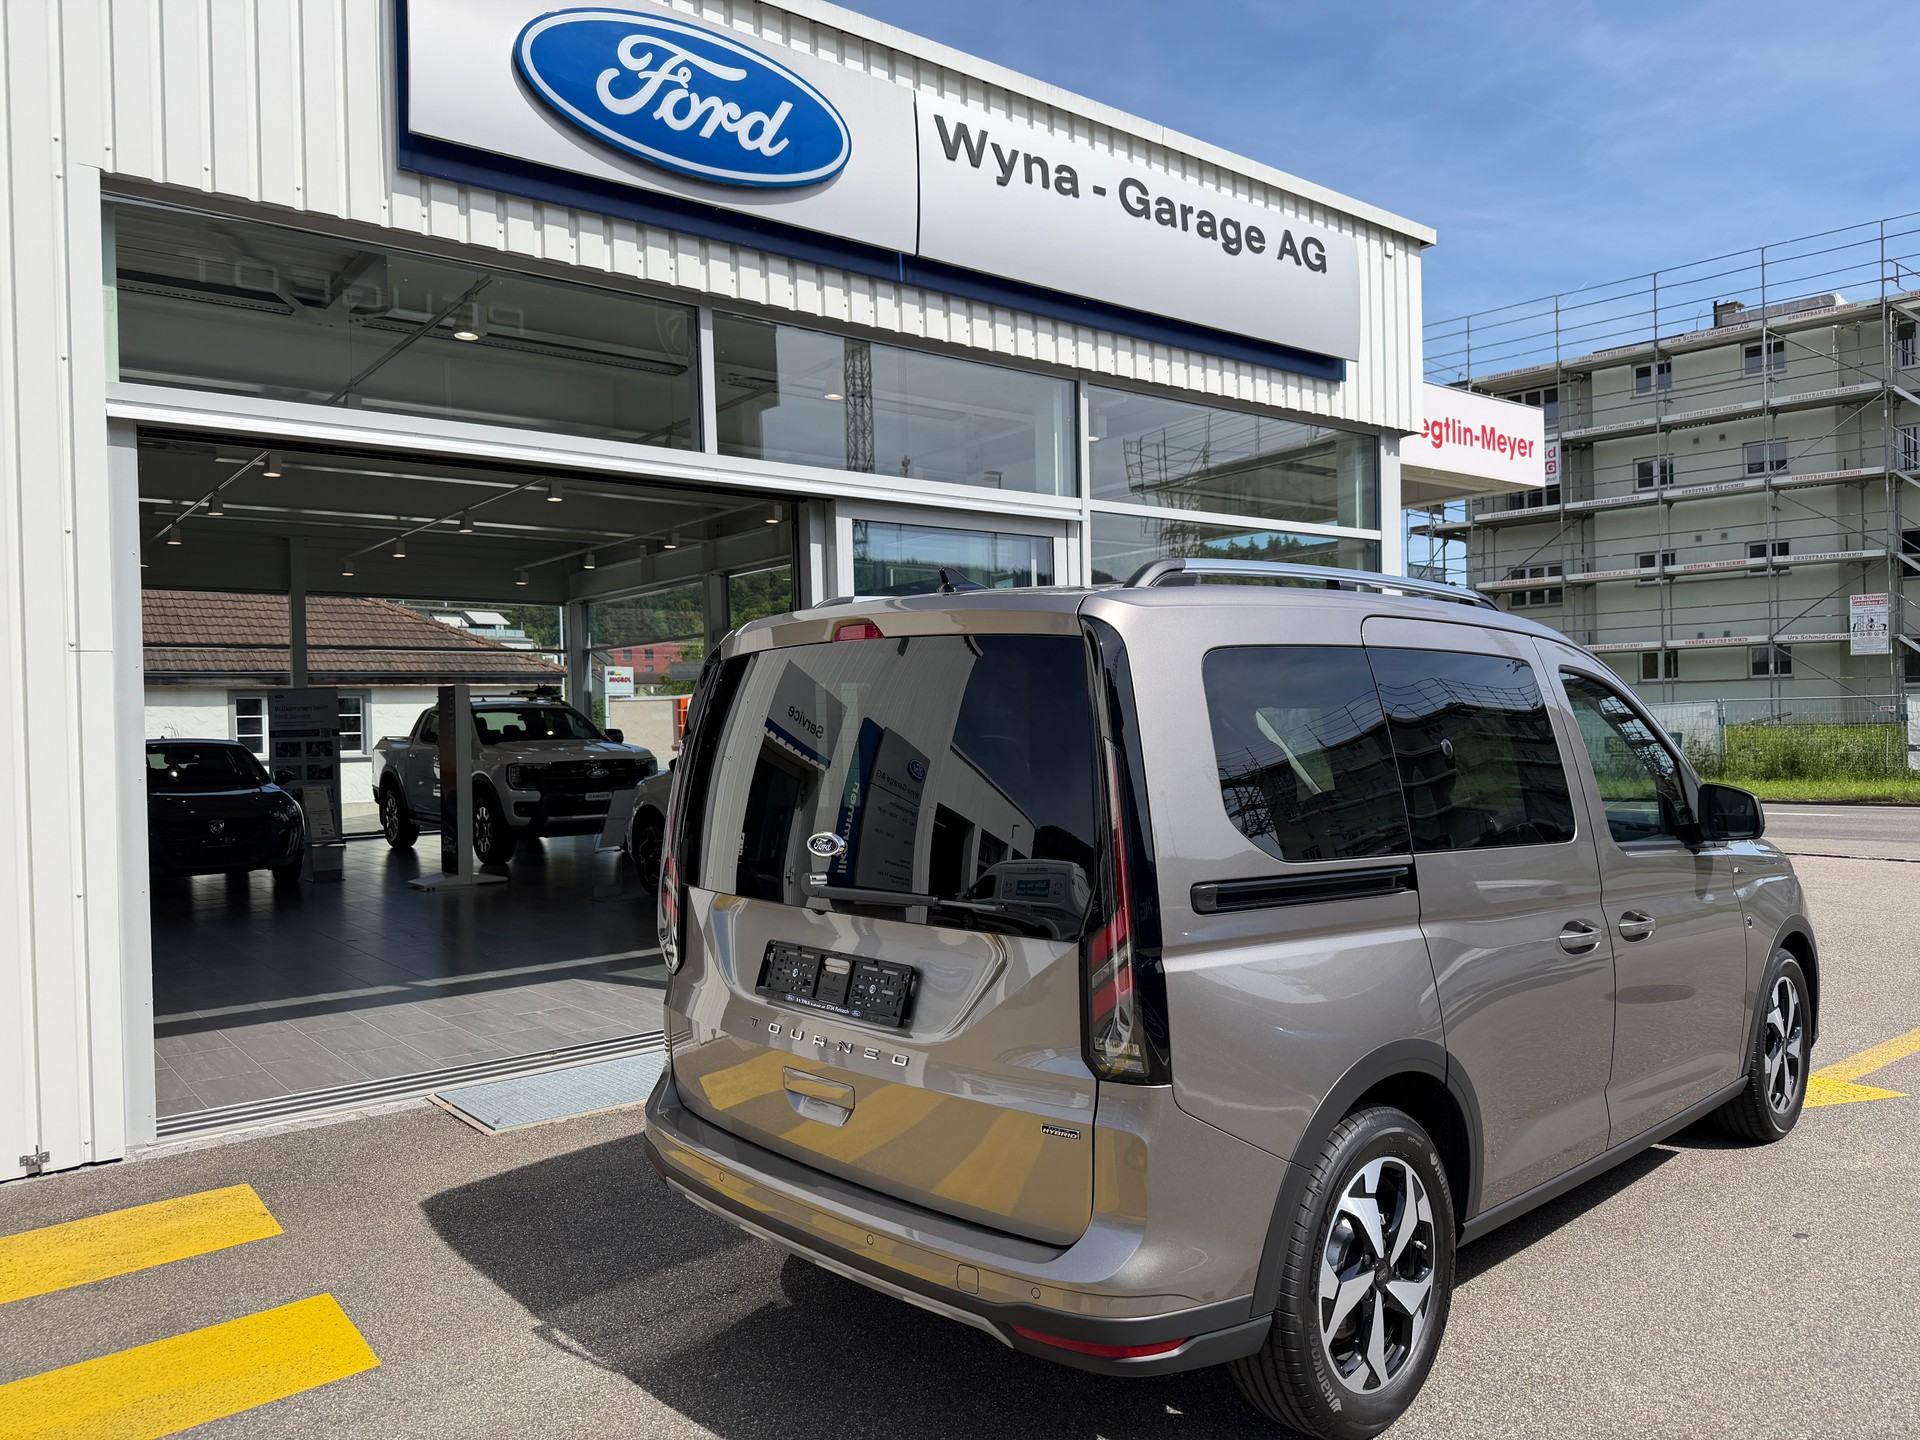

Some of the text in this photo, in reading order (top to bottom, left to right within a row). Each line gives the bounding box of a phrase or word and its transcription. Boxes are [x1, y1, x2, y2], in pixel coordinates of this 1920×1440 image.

[597, 34, 793, 157] Ford
[933, 114, 1328, 273] Wyna - Garage AG
[1683, 333, 1705, 342] Schmid
[1706, 326, 1738, 337] Gerüstbau
[1839, 469, 1862, 477] SCHMID
[1683, 562, 1713, 570] GERÜSTBA
[608, 676, 632, 684] MIGROL
[813, 837, 833, 852] Ford
[750, 1016, 910, 1067] TOURNEO
[1042, 1128, 1078, 1139] HYBRID
